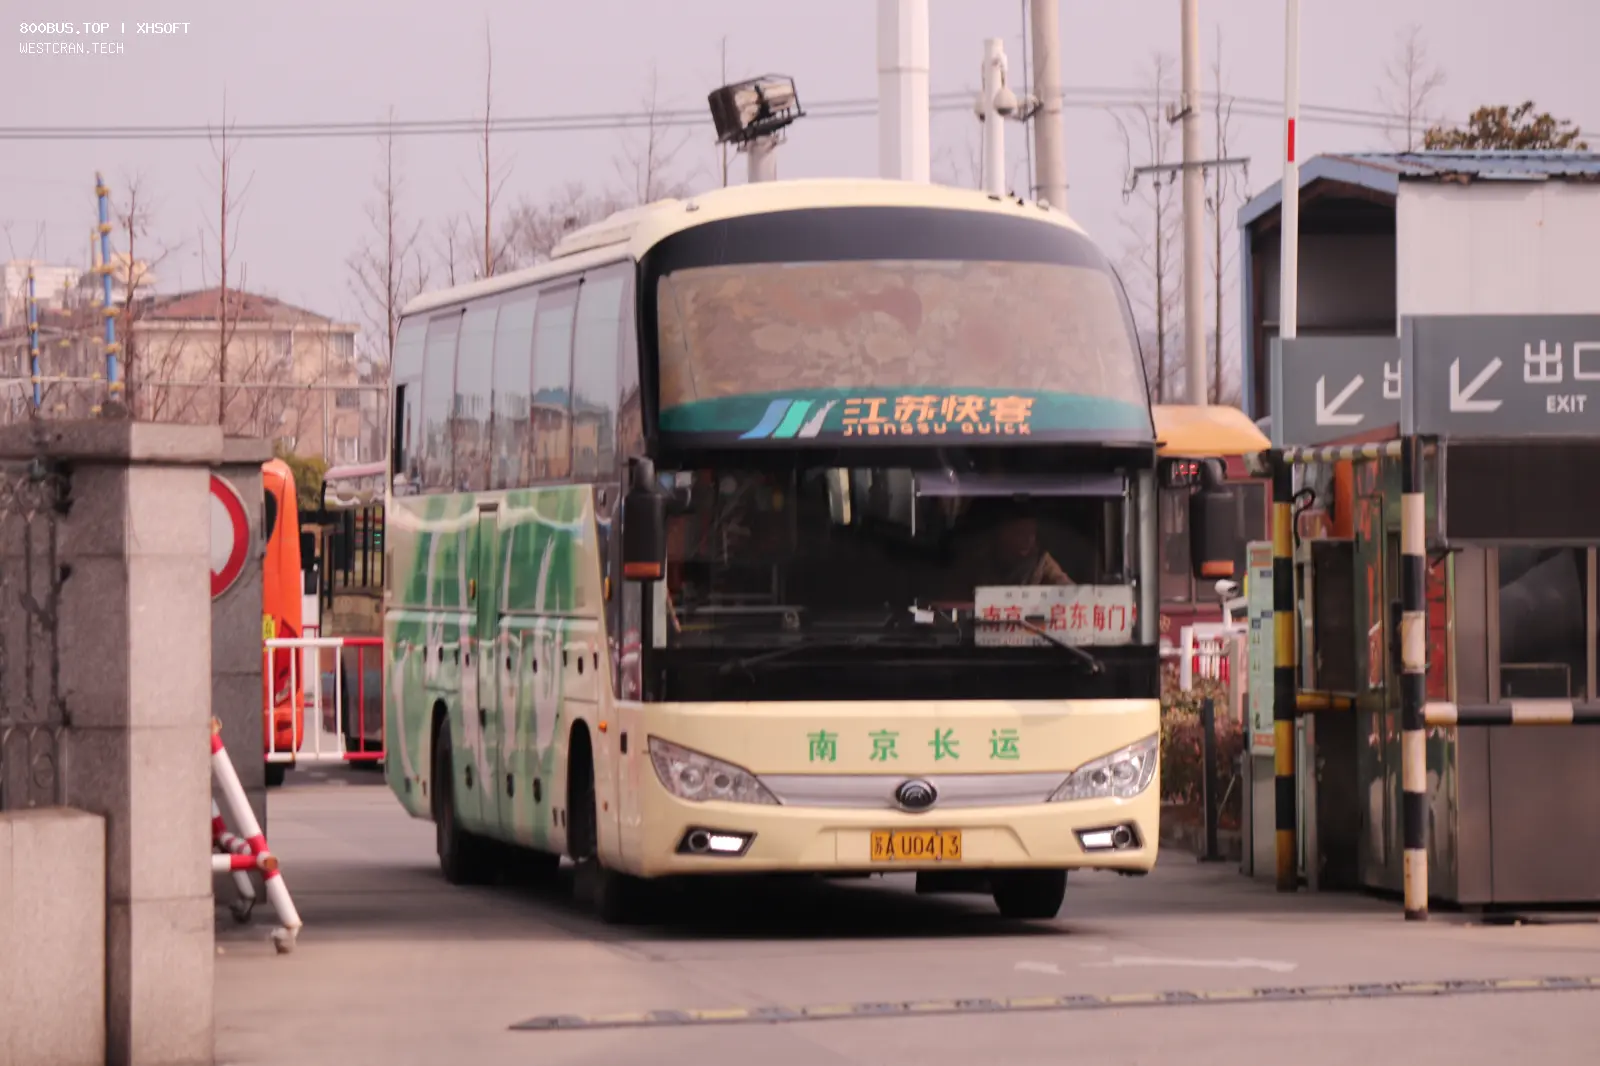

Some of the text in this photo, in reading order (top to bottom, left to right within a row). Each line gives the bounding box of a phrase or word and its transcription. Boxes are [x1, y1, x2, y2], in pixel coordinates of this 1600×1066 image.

[842, 395, 1035, 423] 江苏快客
[1546, 395, 1588, 413] EXIT
[807, 728, 1020, 762] 南京长运
